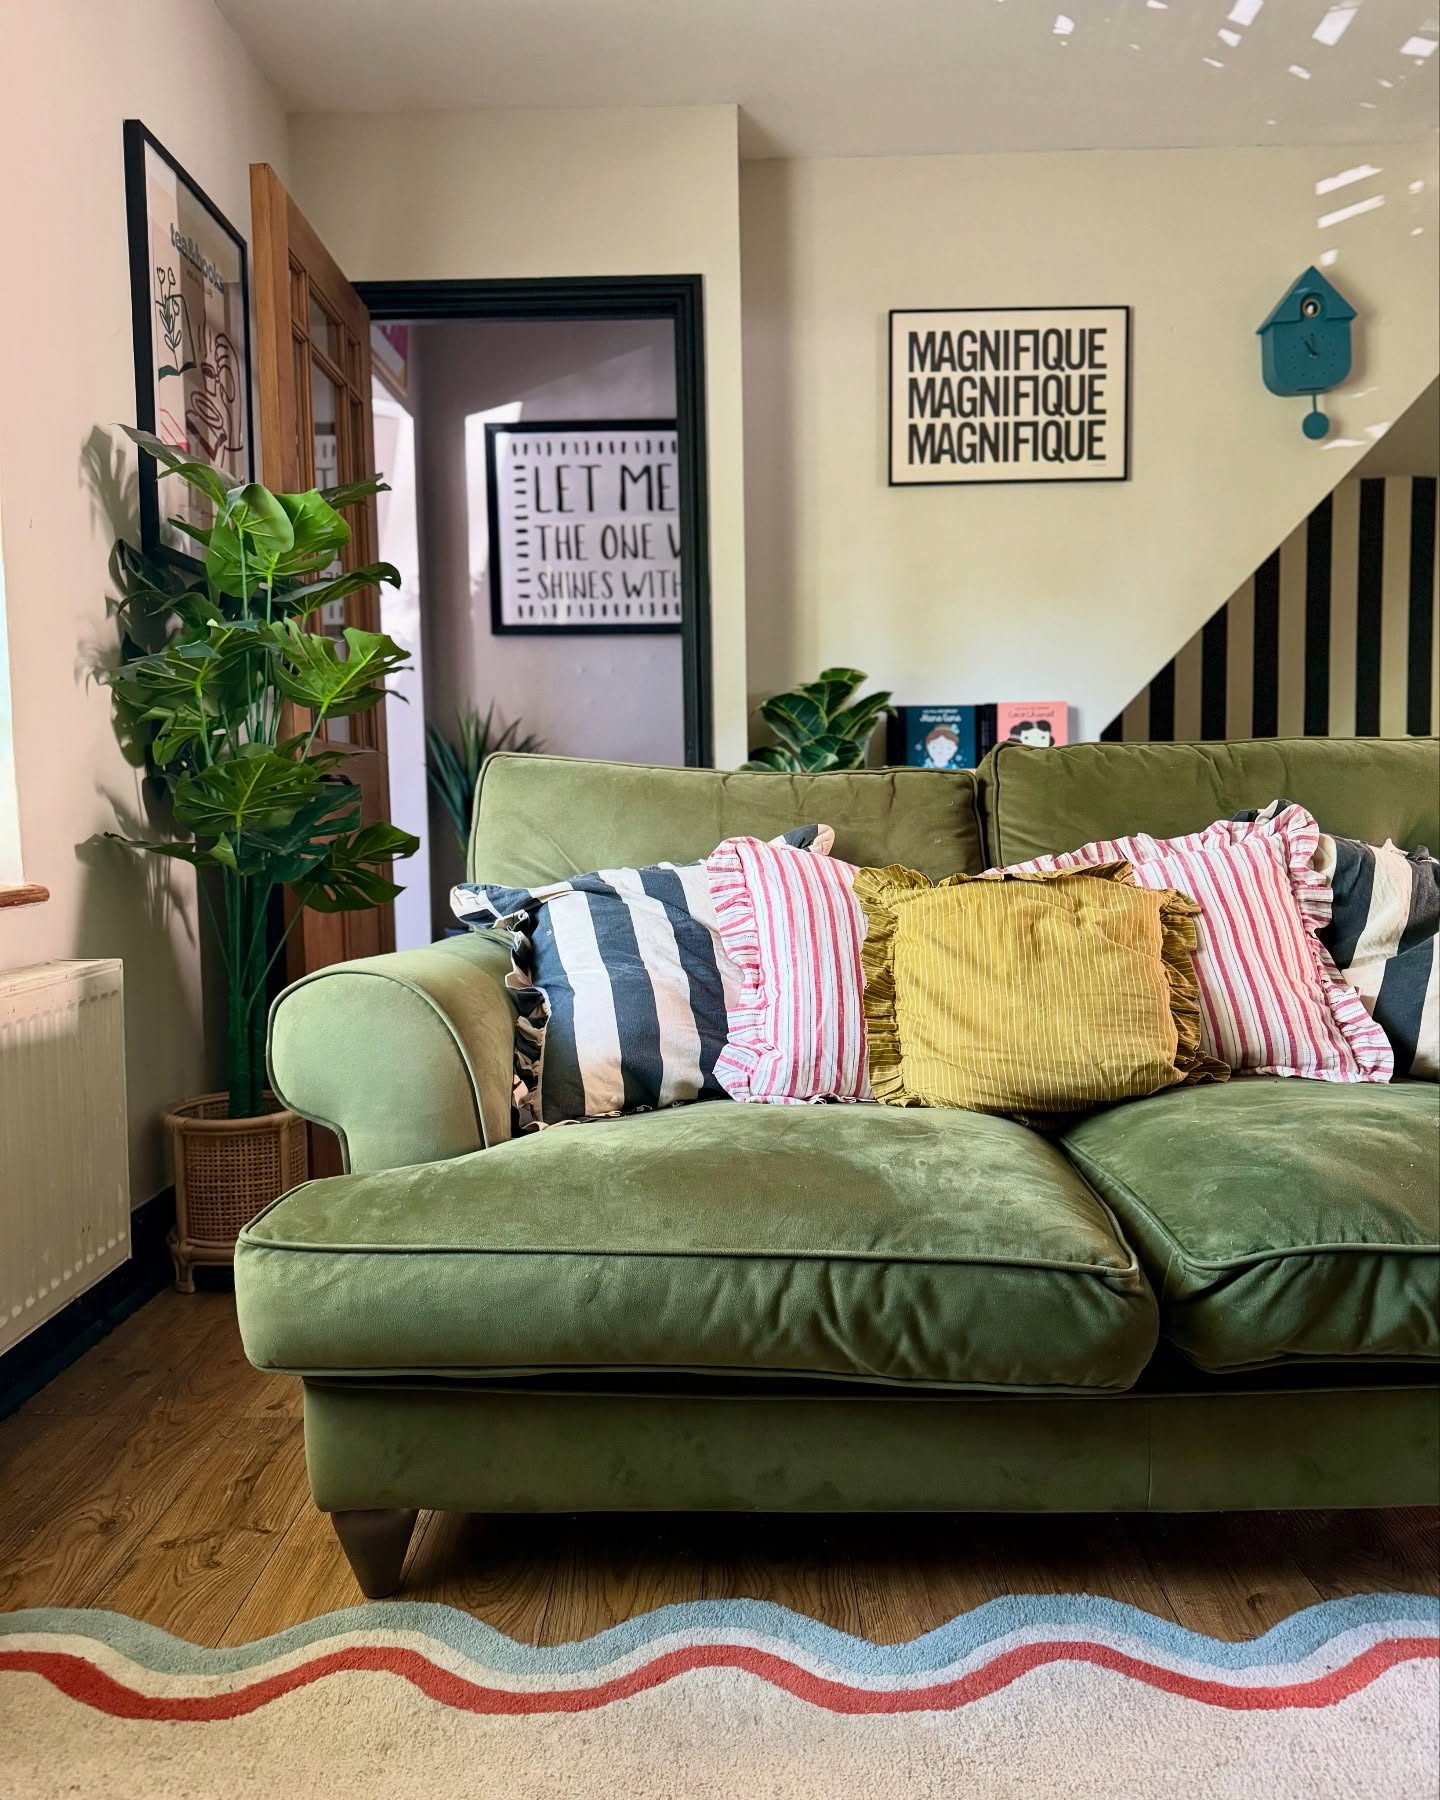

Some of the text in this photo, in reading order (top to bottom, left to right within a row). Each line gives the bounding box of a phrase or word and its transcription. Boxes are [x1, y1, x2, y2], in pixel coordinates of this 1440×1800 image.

[908, 328, 1107, 372] MAGNIFIQUE
[908, 374, 1107, 418] MAGNIFIQUE
[908, 420, 1106, 464] MAGNIFIQUE
[534, 463, 676, 513] LET ME
[534, 524, 589, 561] THE
[601, 523, 655, 560] ONE
[537, 570, 613, 600] SHINES
